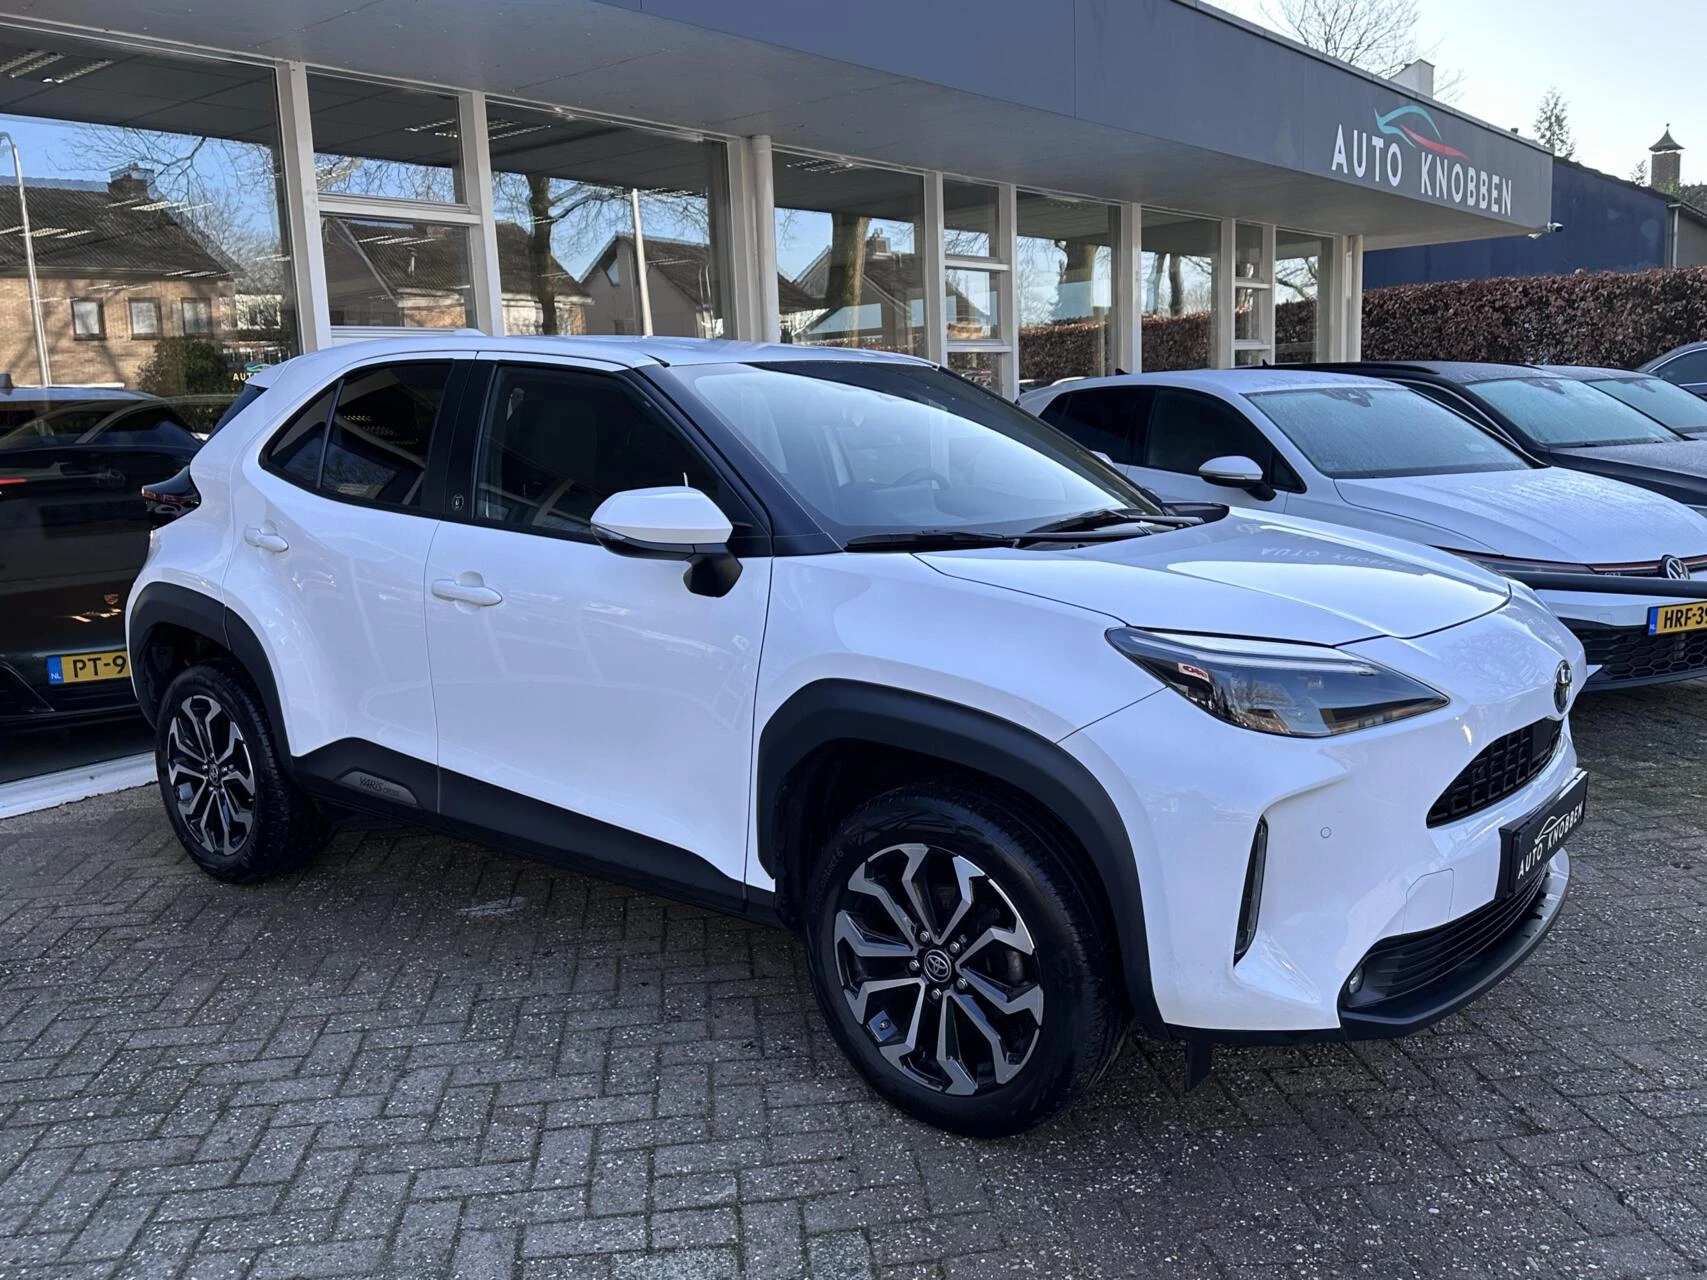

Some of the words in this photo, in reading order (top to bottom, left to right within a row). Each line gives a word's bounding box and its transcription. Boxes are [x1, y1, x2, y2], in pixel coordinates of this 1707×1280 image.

[1331, 123, 1402, 187] AUTO
[1420, 151, 1512, 216] KNOBBEN
[232, 371, 257, 382] AUT
[1663, 606, 1707, 629] HRF-3
[50, 672, 62, 680] NL
[72, 655, 127, 679] PT-9
[1518, 842, 1543, 880] AUTO
[1547, 800, 1584, 850] KNOBBEN
